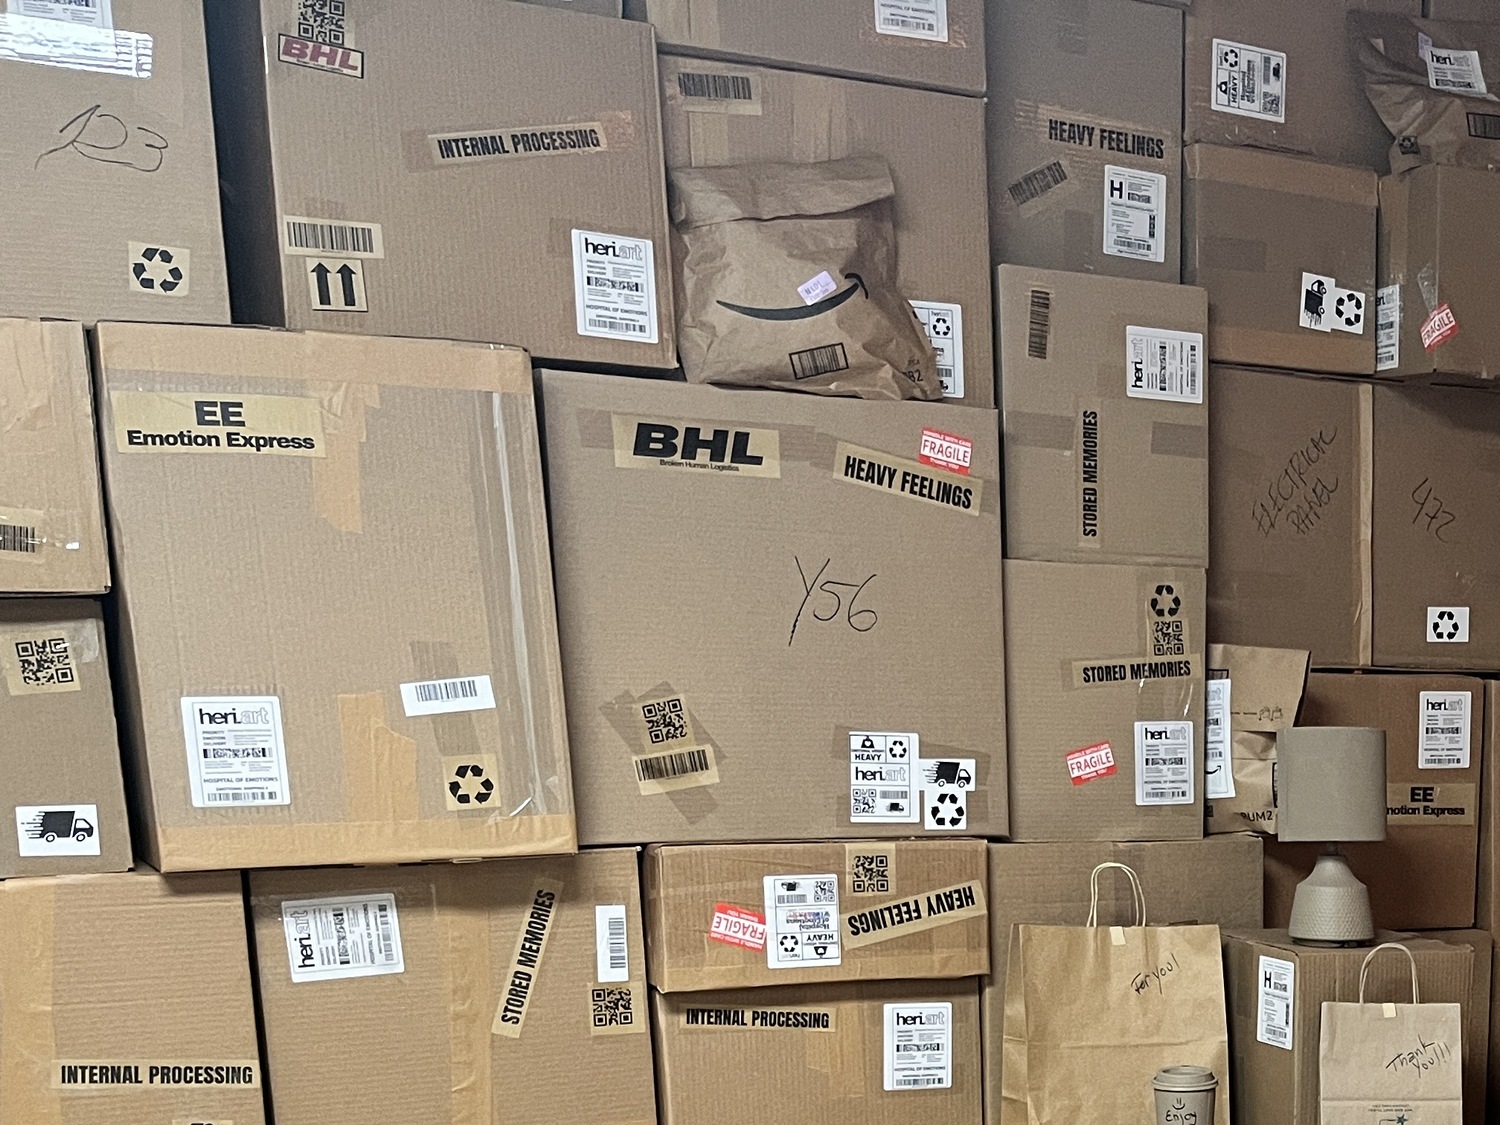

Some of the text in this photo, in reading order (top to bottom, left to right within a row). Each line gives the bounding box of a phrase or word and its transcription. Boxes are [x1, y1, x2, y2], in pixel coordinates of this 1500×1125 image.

[282, 41, 359, 72] BHL
[437, 129, 601, 160] INTERNAL PROCESSING
[1049, 119, 1165, 159] HEAVY FEELINGS
[1110, 180, 1123, 199] H
[1422, 311, 1456, 348] FRAGILE
[194, 400, 246, 427] EE
[127, 430, 315, 452] Emotion Express
[633, 423, 764, 466] BHL
[922, 440, 970, 464] FRAGILE
[844, 456, 973, 510] HEAVY FEELINGS
[1082, 410, 1098, 538] STORED MEMORIES
[1082, 660, 1192, 684] STORED MEMORIES
[854, 753, 882, 761] HEAVY
[1069, 753, 1112, 778] FRAGILE
[1410, 787, 1434, 802] EE
[1424, 806, 1466, 818] Express
[847, 885, 975, 937] HEAVY FEELINGS
[713, 914, 765, 942] FRAGILE
[806, 933, 834, 941] HEAVY
[501, 889, 556, 1025] STORED MEMORIES
[1264, 971, 1272, 989] H
[686, 1008, 830, 1029] INTERNAL PROCESSING
[61, 1064, 253, 1085] INTERNAL PROCESSING
